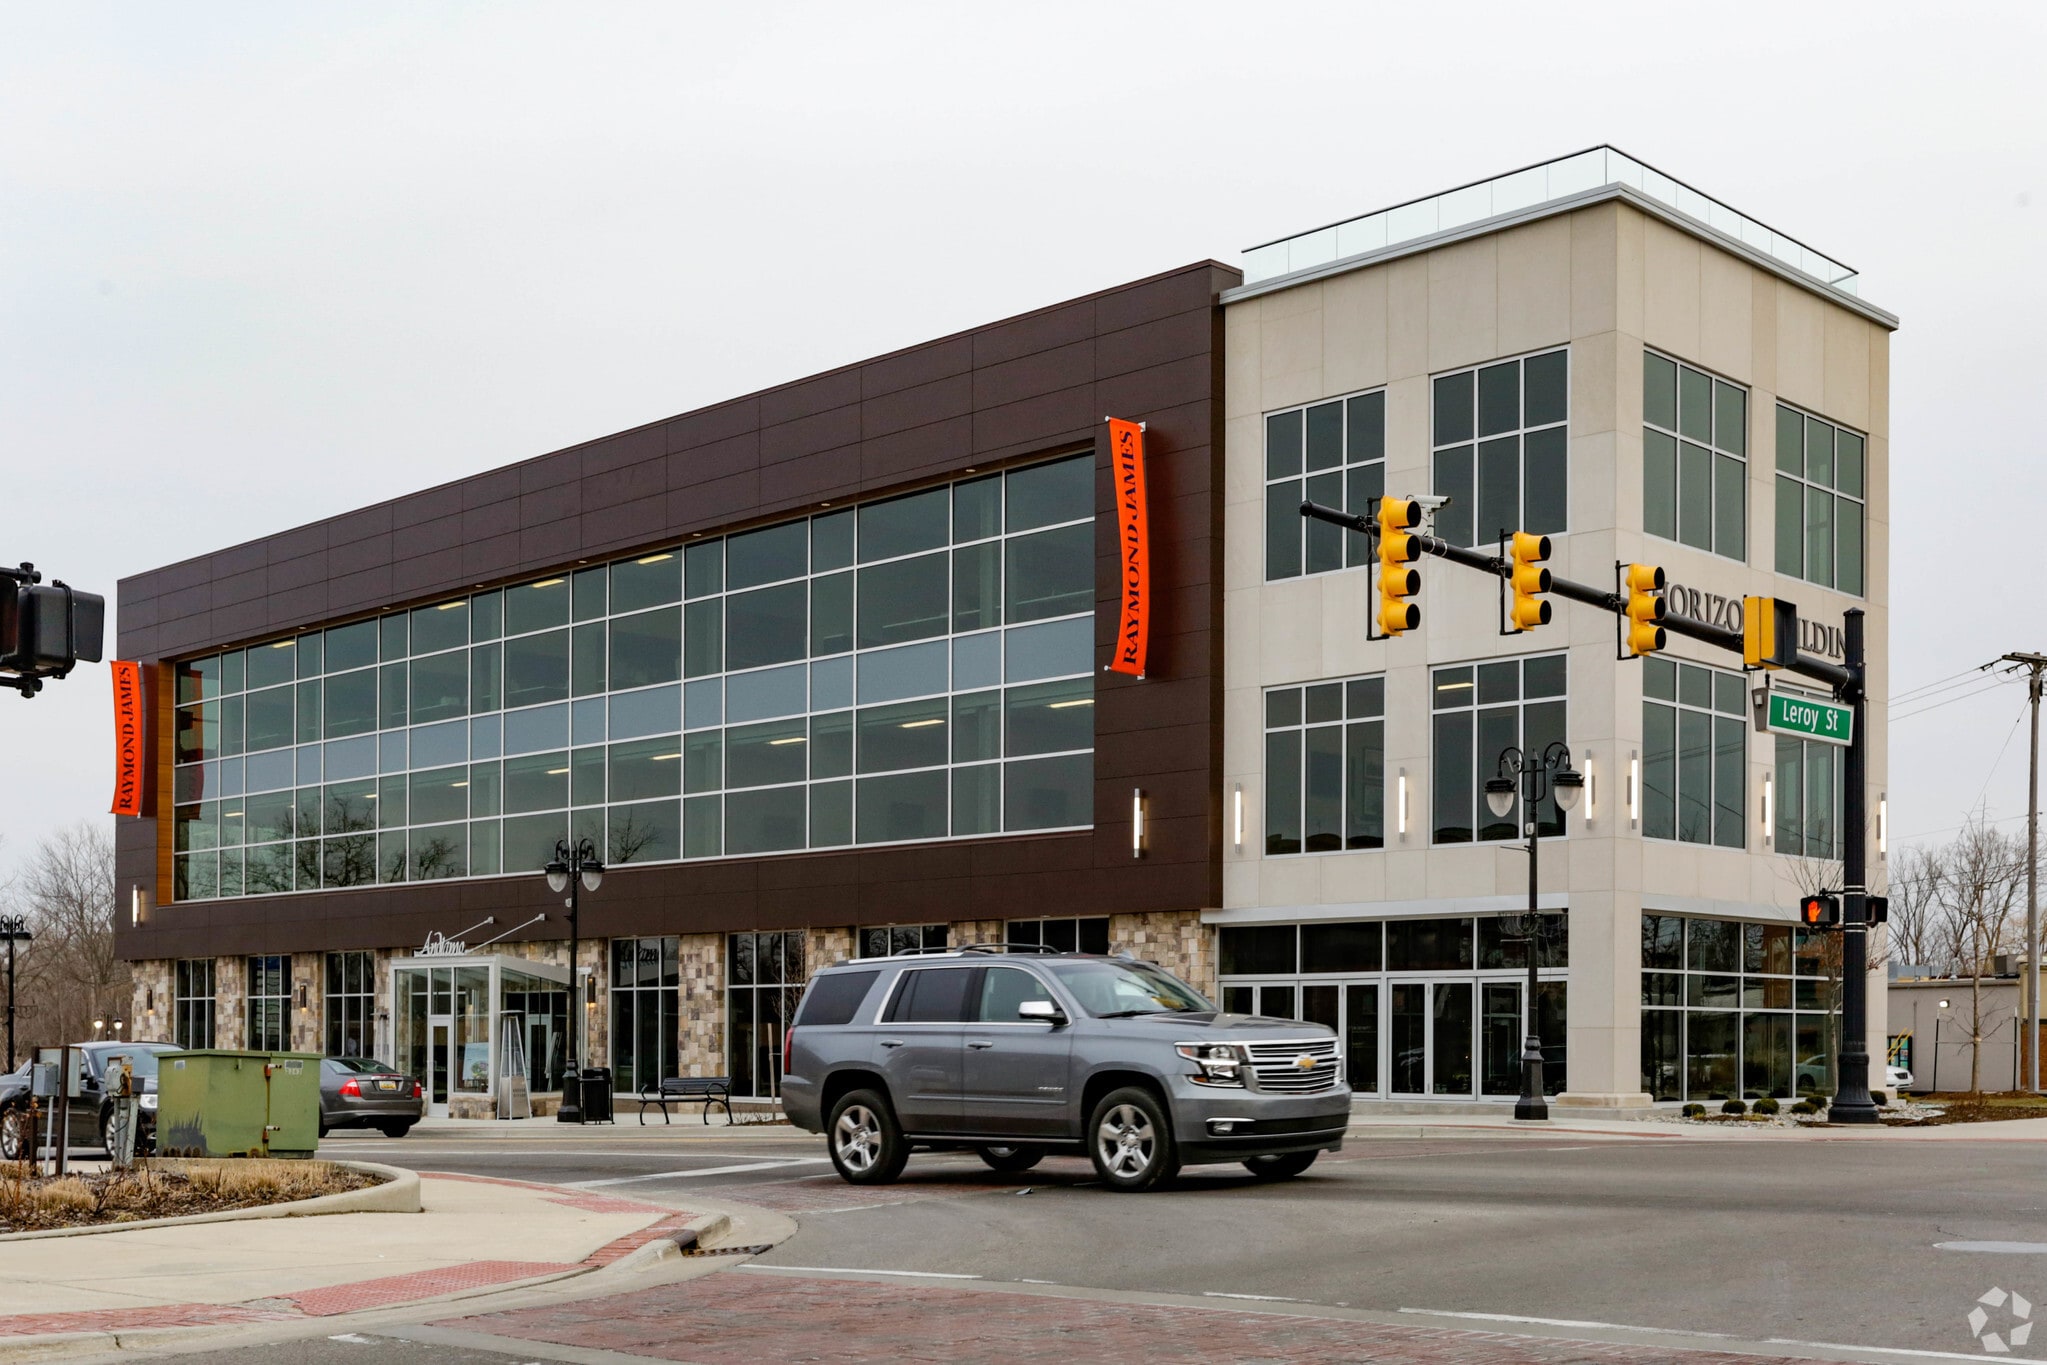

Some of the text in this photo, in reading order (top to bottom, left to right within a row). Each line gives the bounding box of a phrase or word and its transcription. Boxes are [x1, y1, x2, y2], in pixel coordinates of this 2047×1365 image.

[1119, 430, 1140, 665] RAYMOND JAMES
[1652, 581, 1744, 633] HORIZO
[118, 667, 135, 809] RAYMOND JAMES
[1783, 700, 1839, 733] Leroy St
